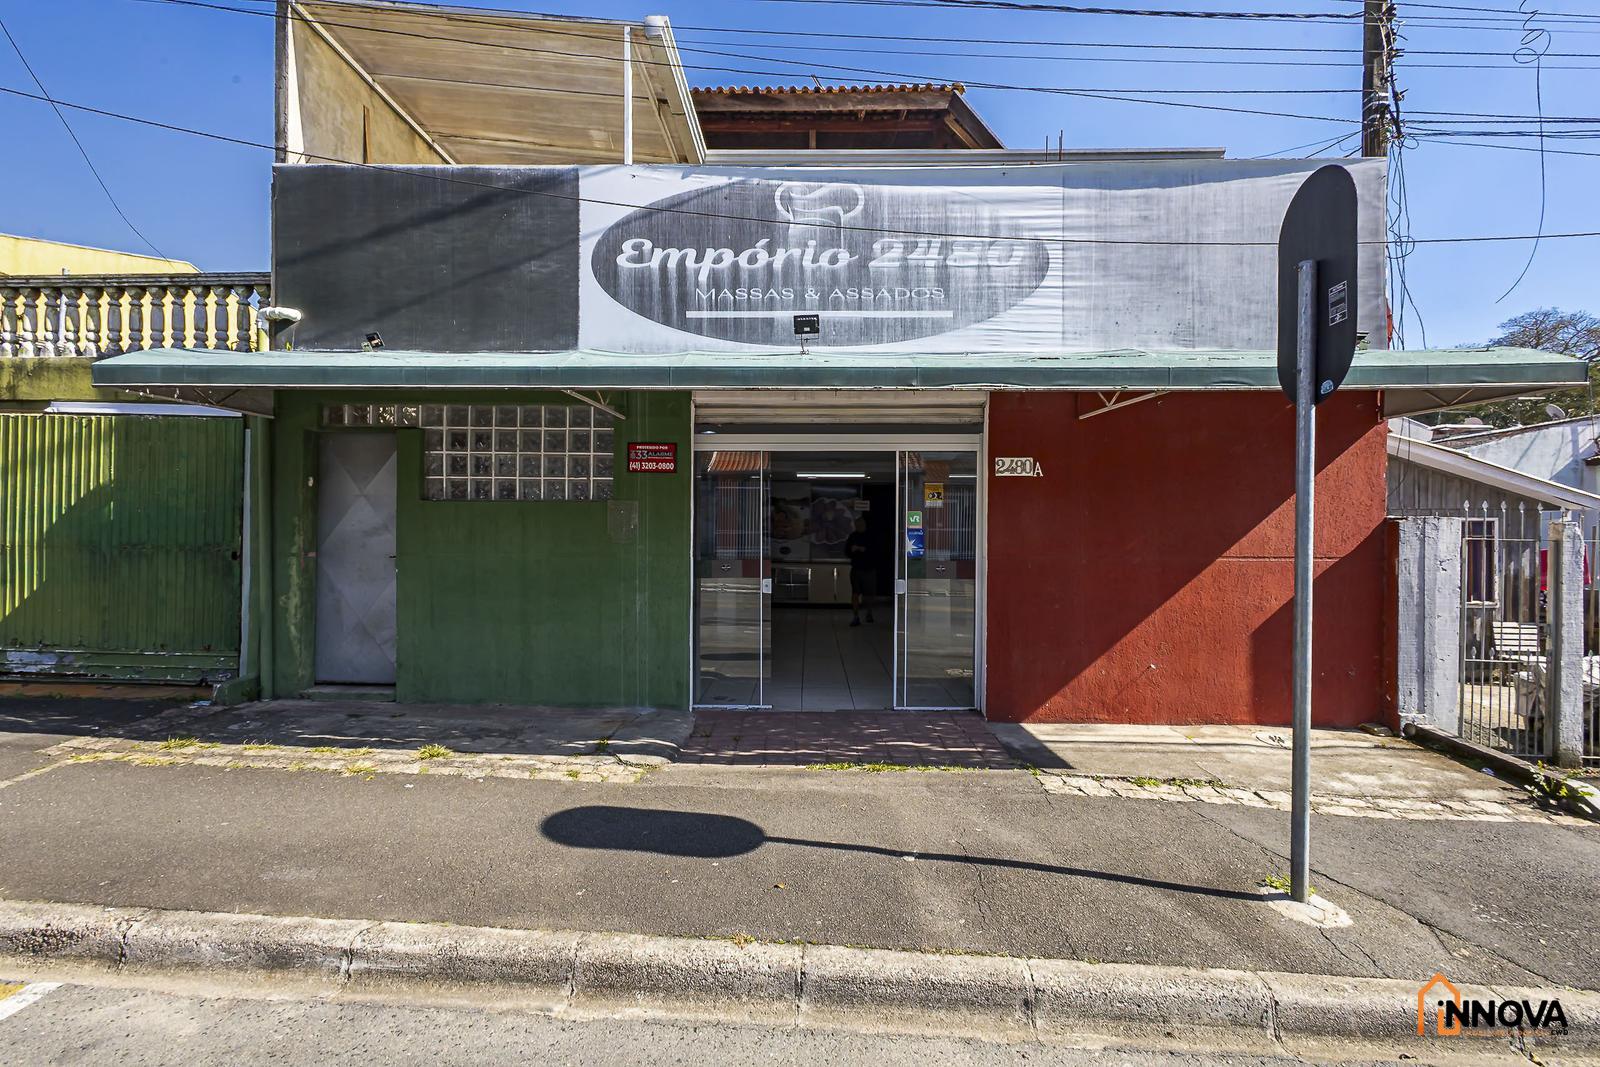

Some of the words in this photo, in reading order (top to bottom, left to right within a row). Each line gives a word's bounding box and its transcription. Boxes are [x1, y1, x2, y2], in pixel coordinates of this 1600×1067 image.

[616, 238, 859, 282] Empório
[868, 238, 1026, 268] 2480
[695, 287, 795, 302] MASSAS
[804, 287, 821, 300] &
[828, 287, 945, 300] ASSADOS
[630, 462, 640, 471] (41)
